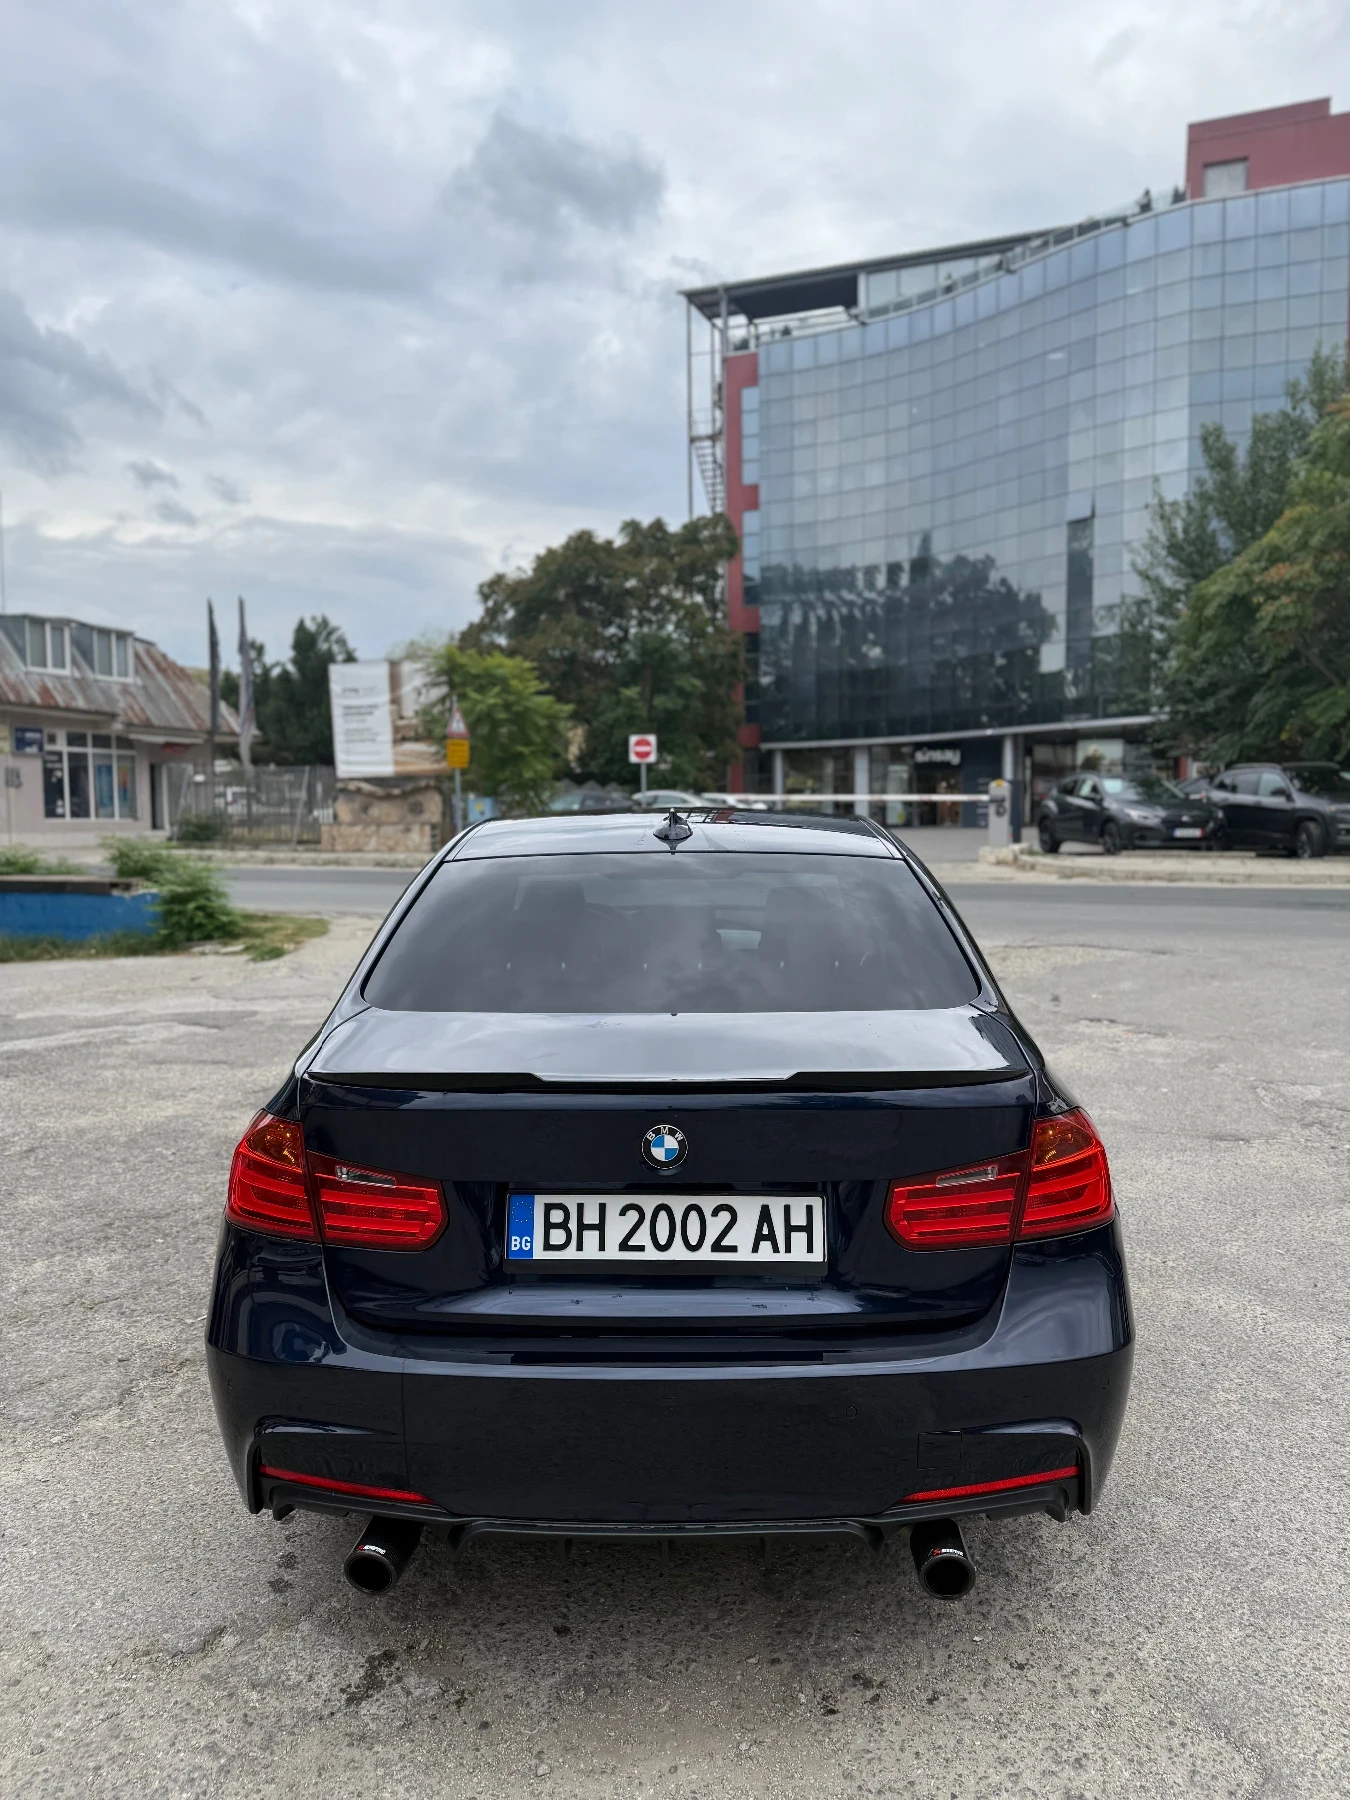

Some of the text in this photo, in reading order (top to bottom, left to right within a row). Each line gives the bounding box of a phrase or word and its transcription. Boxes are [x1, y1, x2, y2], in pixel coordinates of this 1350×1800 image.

[646, 1126, 684, 1141] BMW
[543, 1202, 814, 1254] BH 2002 AH
[511, 1236, 531, 1251] BG
